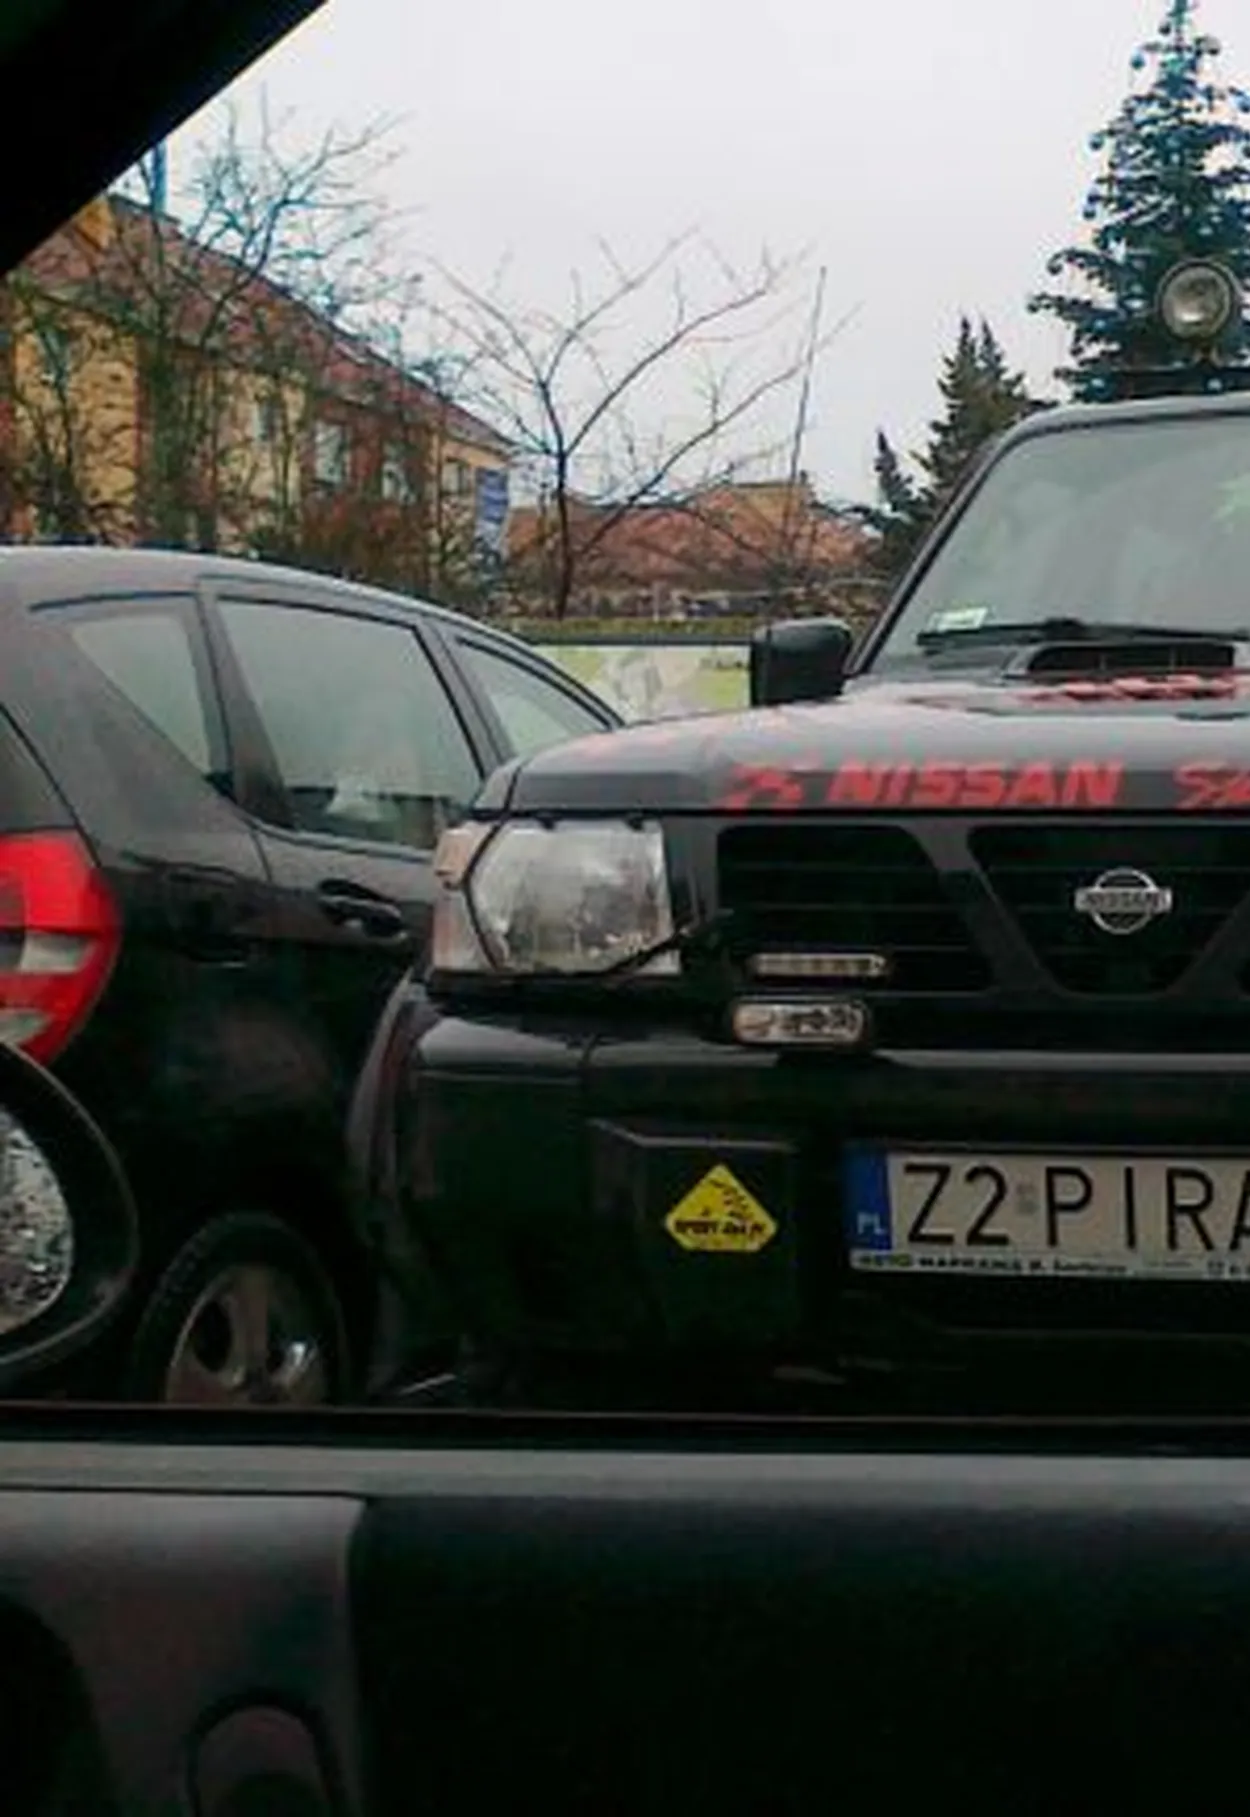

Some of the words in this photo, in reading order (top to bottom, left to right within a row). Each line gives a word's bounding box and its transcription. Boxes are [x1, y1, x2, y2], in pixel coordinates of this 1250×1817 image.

[828, 763, 1123, 809] NISSAN
[856, 1212, 888, 1236] PL
[902, 1162, 1011, 1246] Z2
